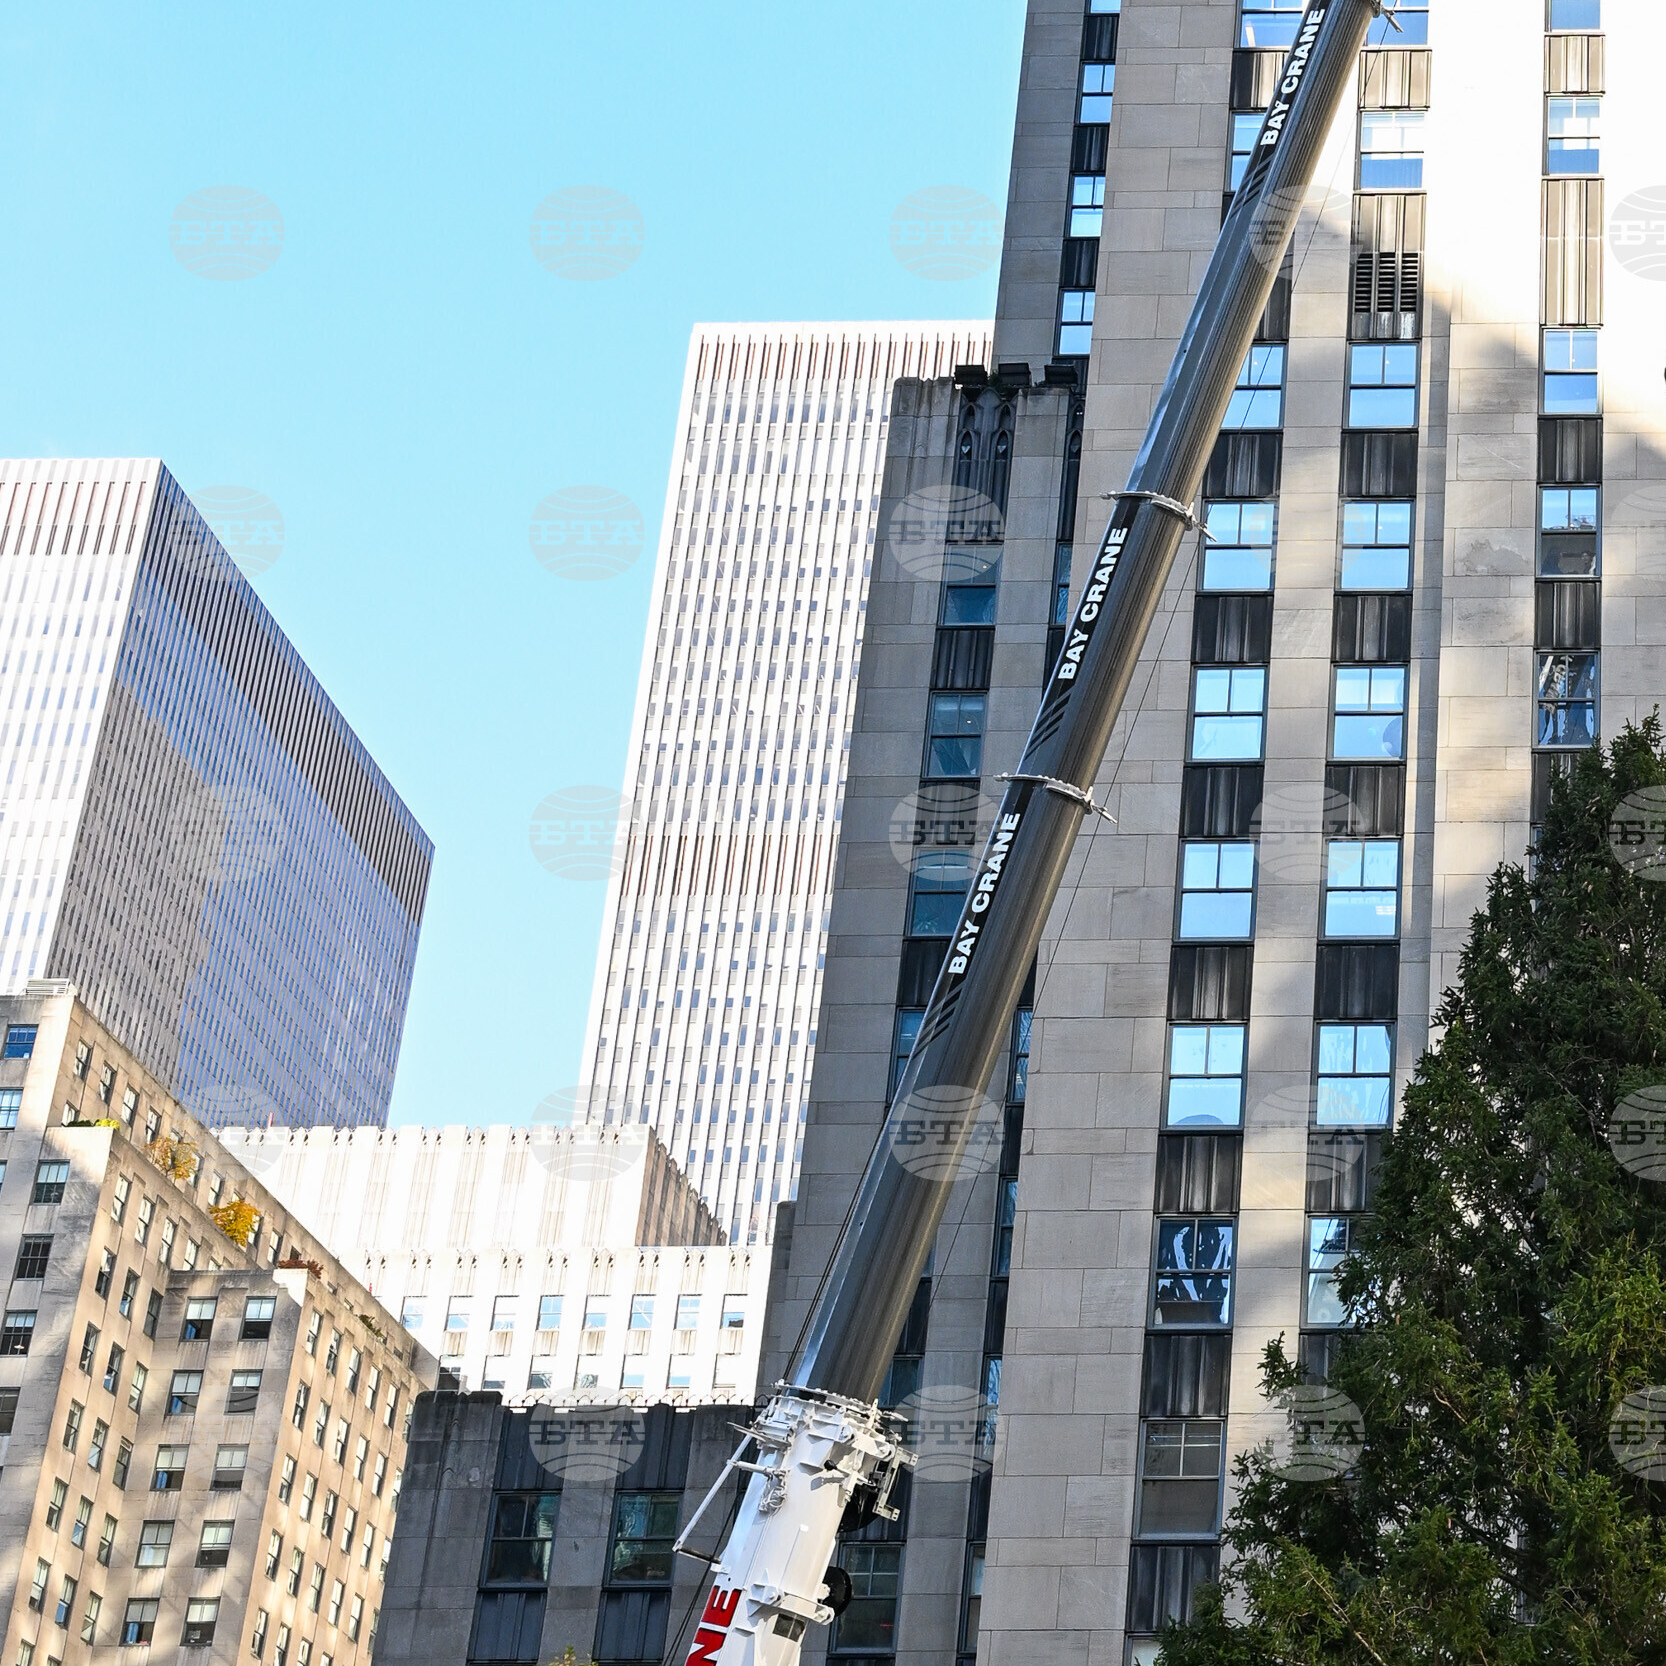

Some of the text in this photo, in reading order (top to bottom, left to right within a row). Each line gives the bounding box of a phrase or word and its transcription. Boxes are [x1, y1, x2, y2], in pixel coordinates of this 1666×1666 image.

[1260, 8, 1326, 147] BAY CRANE
[1058, 527, 1129, 681] BAY CRANE
[948, 812, 1021, 975] BAY CRANE
